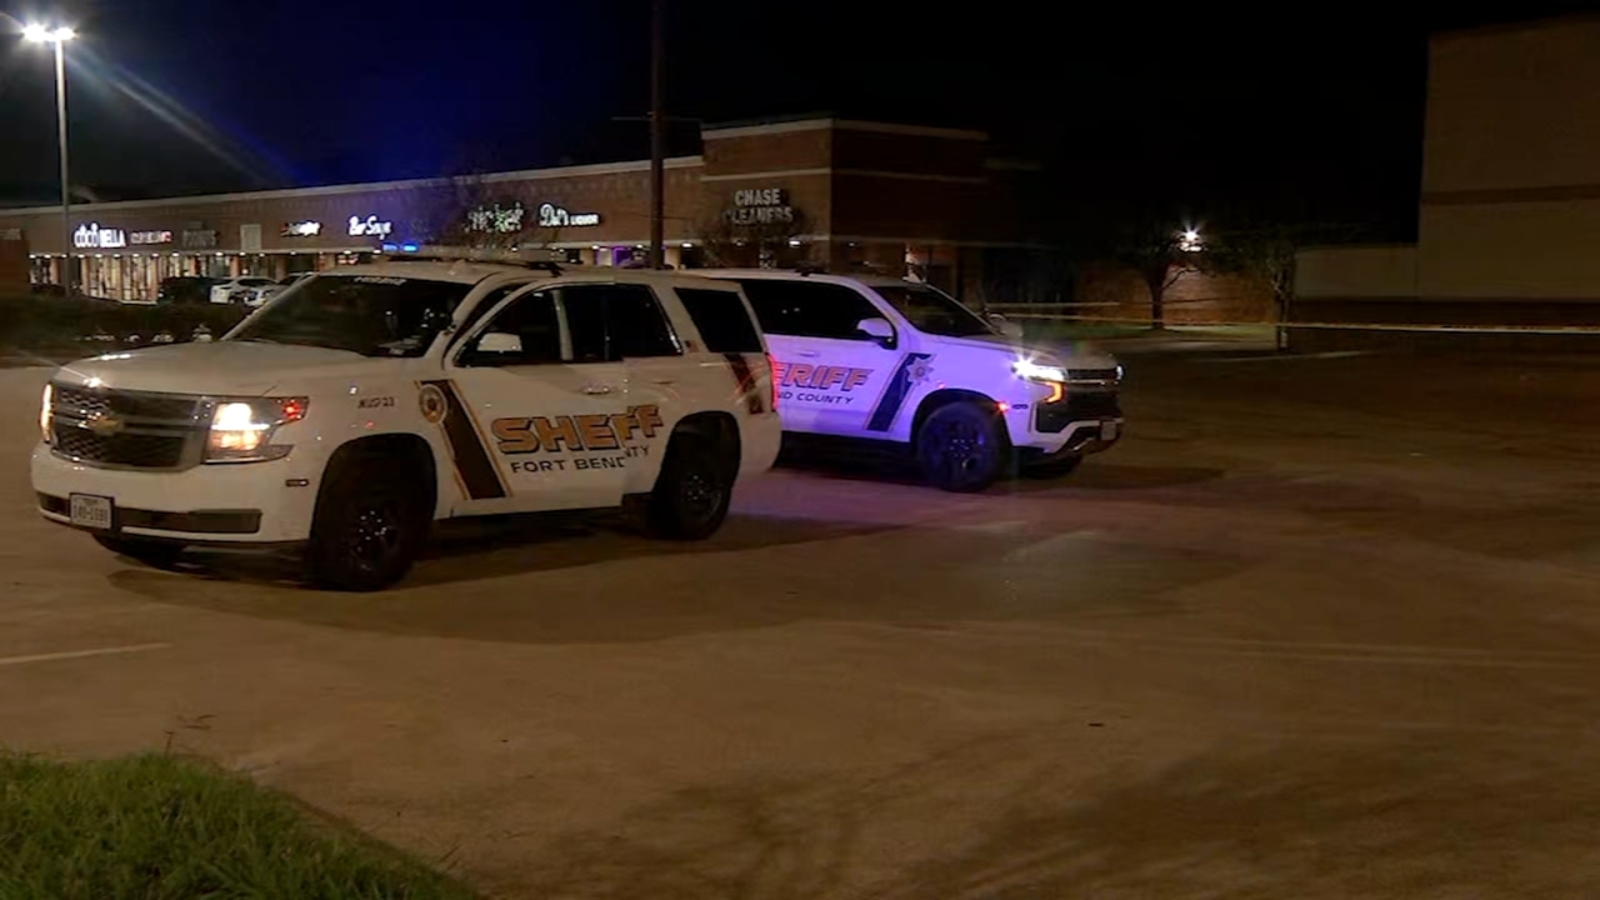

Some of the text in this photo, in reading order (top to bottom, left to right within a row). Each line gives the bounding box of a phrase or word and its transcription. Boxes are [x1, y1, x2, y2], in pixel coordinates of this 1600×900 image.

[734, 188, 781, 206] CHASE
[722, 205, 793, 225] CLEANERS
[796, 393, 854, 405] COUNTY
[510, 459, 567, 474] FORT
